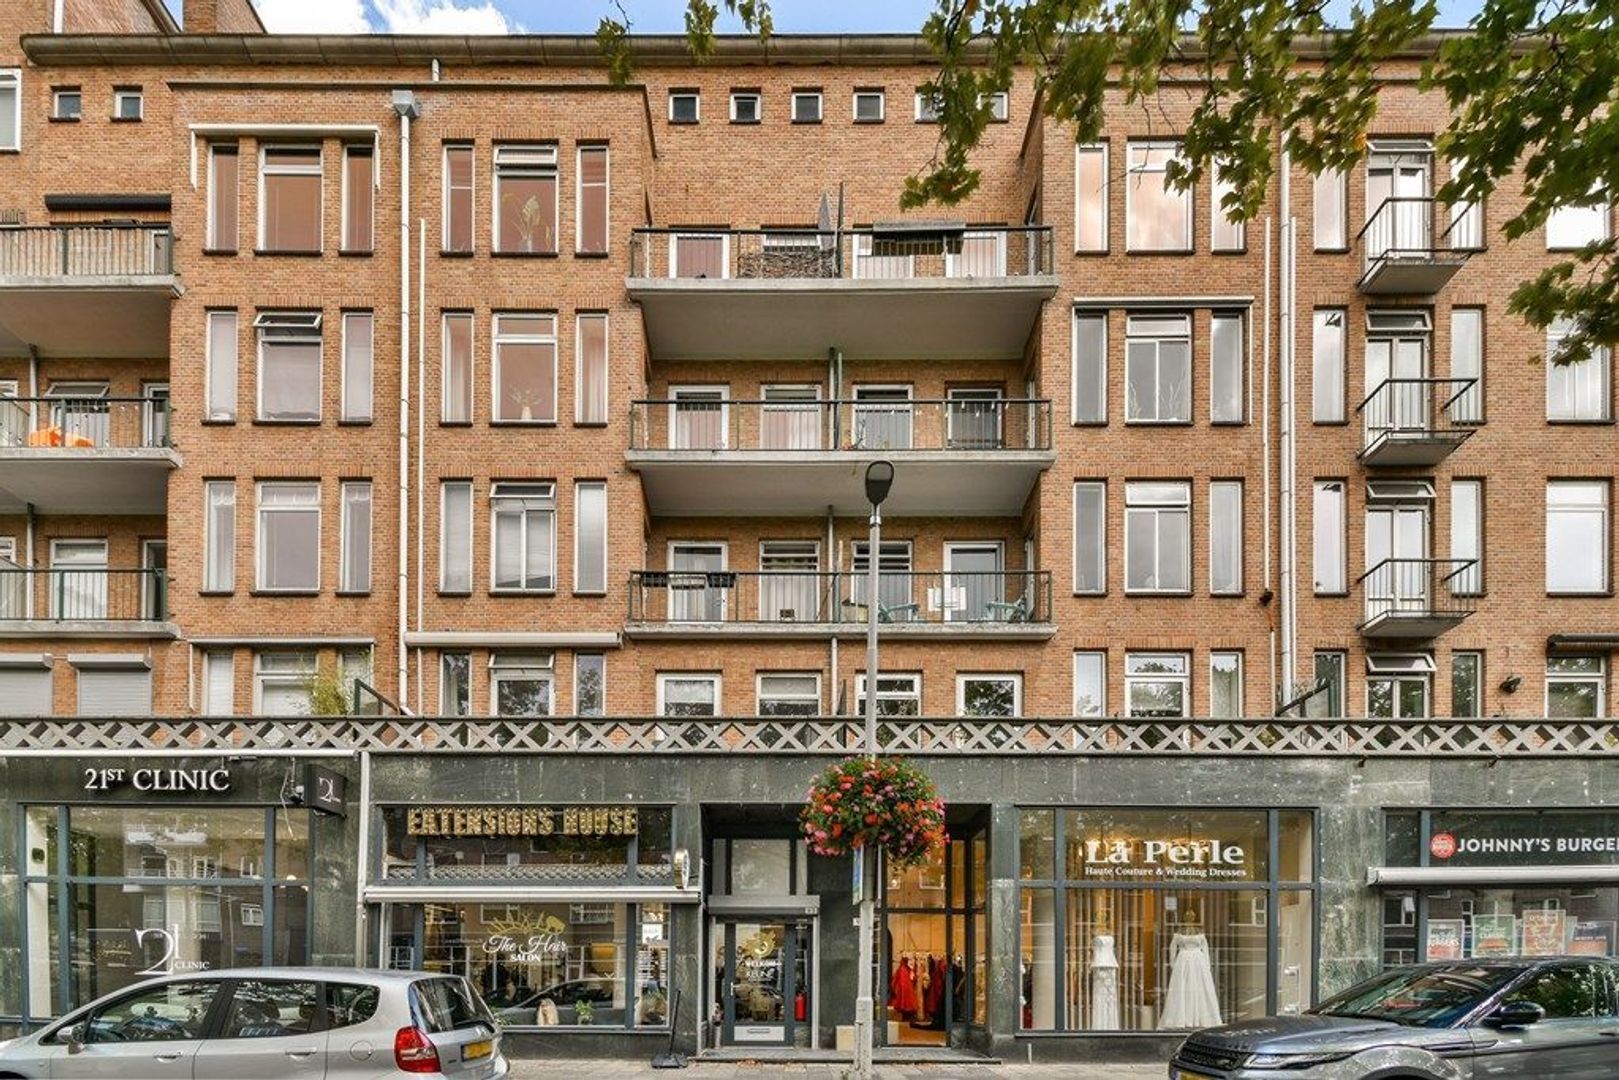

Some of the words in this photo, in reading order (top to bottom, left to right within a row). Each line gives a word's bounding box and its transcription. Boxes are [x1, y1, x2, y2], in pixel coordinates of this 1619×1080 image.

[132, 768, 230, 791] CLINIC
[563, 806, 638, 836] HOUSE
[1085, 839, 1130, 864] La
[1143, 839, 1244, 864] Perle
[1457, 838, 1551, 853] JOHNNY'S
[1556, 838, 1619, 852] BURGE
[1085, 866, 1113, 876] Haute
[1114, 866, 1153, 876] Couture
[1155, 867, 1164, 876] &
[1165, 866, 1207, 878] Wedding
[1209, 867, 1248, 877] Dresses
[482, 934, 518, 954] The
[519, 933, 567, 955] Hair
[174, 961, 210, 970] CLINIC
[510, 953, 541, 963] SALON
